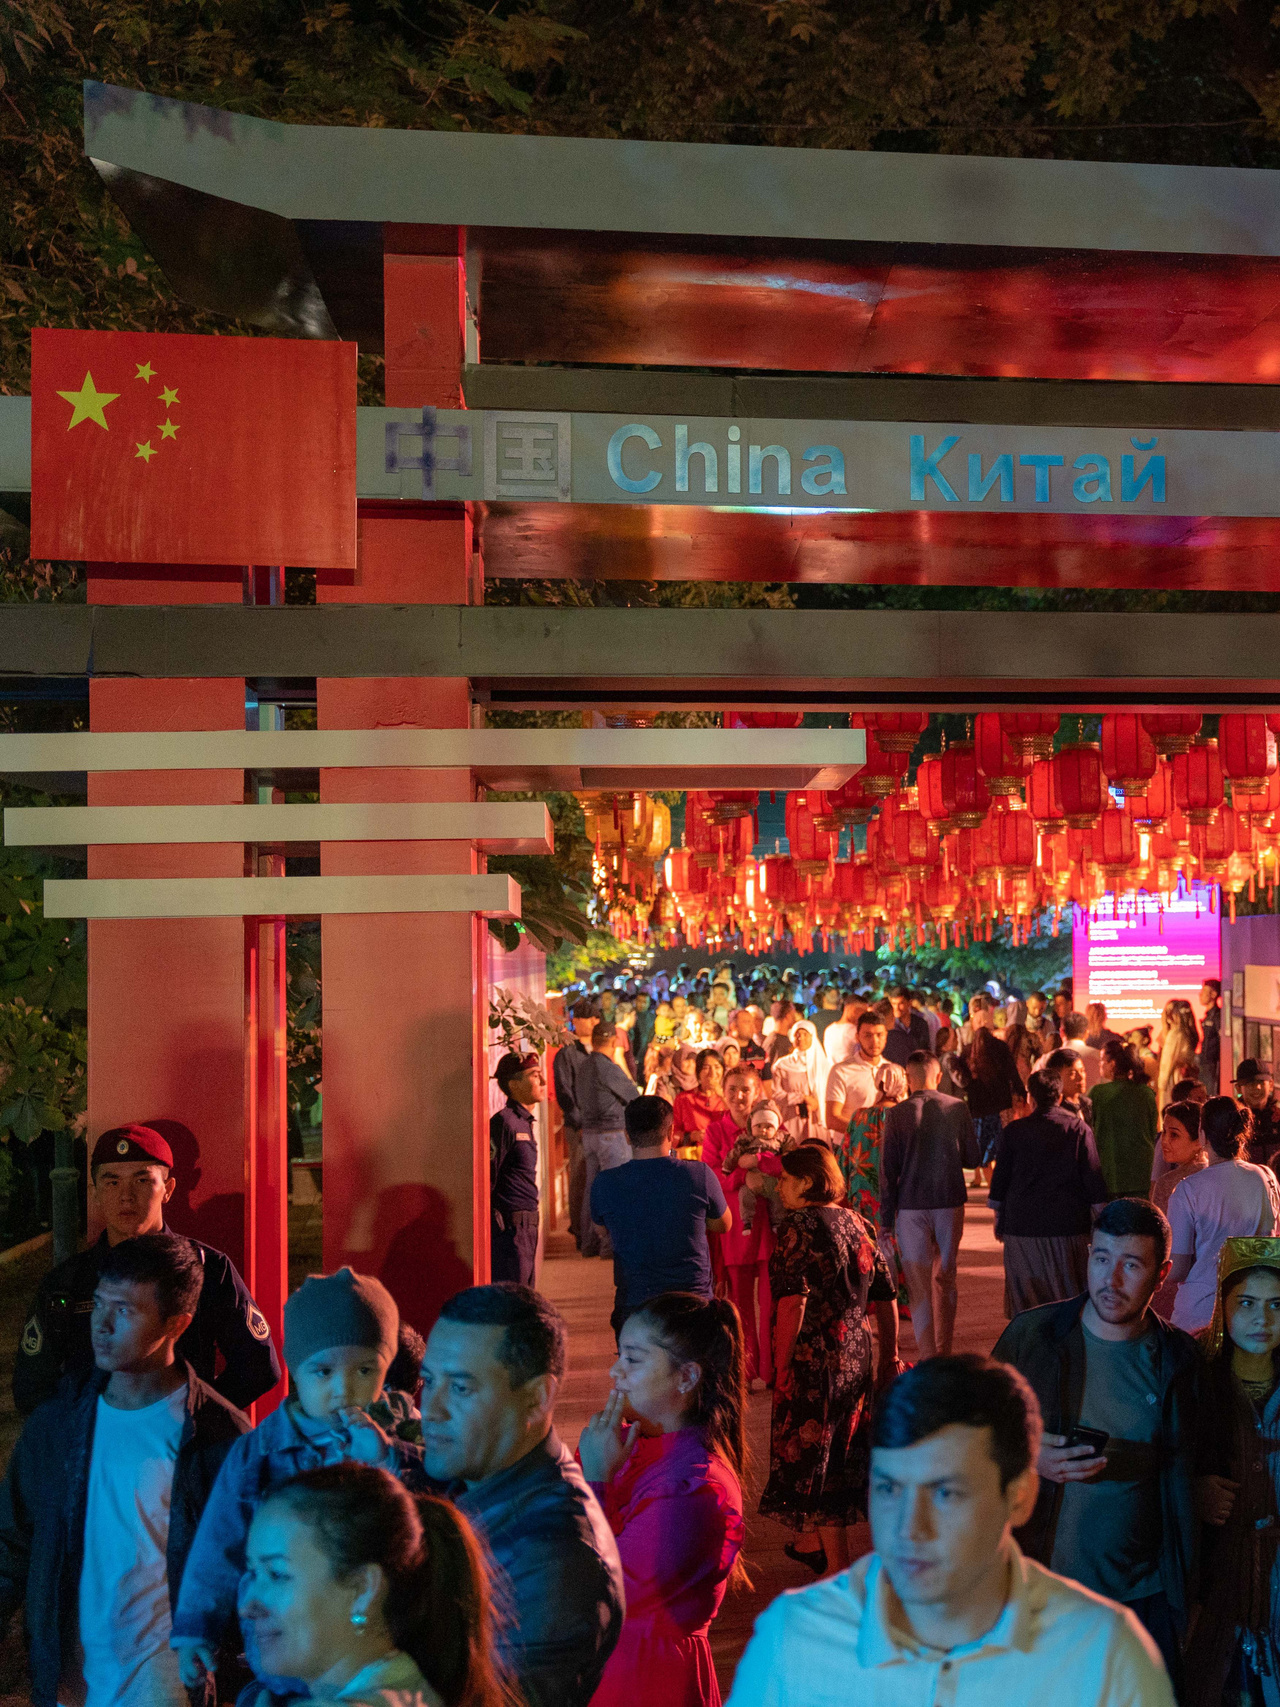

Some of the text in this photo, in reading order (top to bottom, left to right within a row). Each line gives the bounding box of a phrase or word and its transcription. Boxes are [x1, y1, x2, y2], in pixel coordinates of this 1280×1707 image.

[385, 405, 572, 502] 中国
[606, 423, 848, 496] China
[909, 434, 1166, 503] Китай
